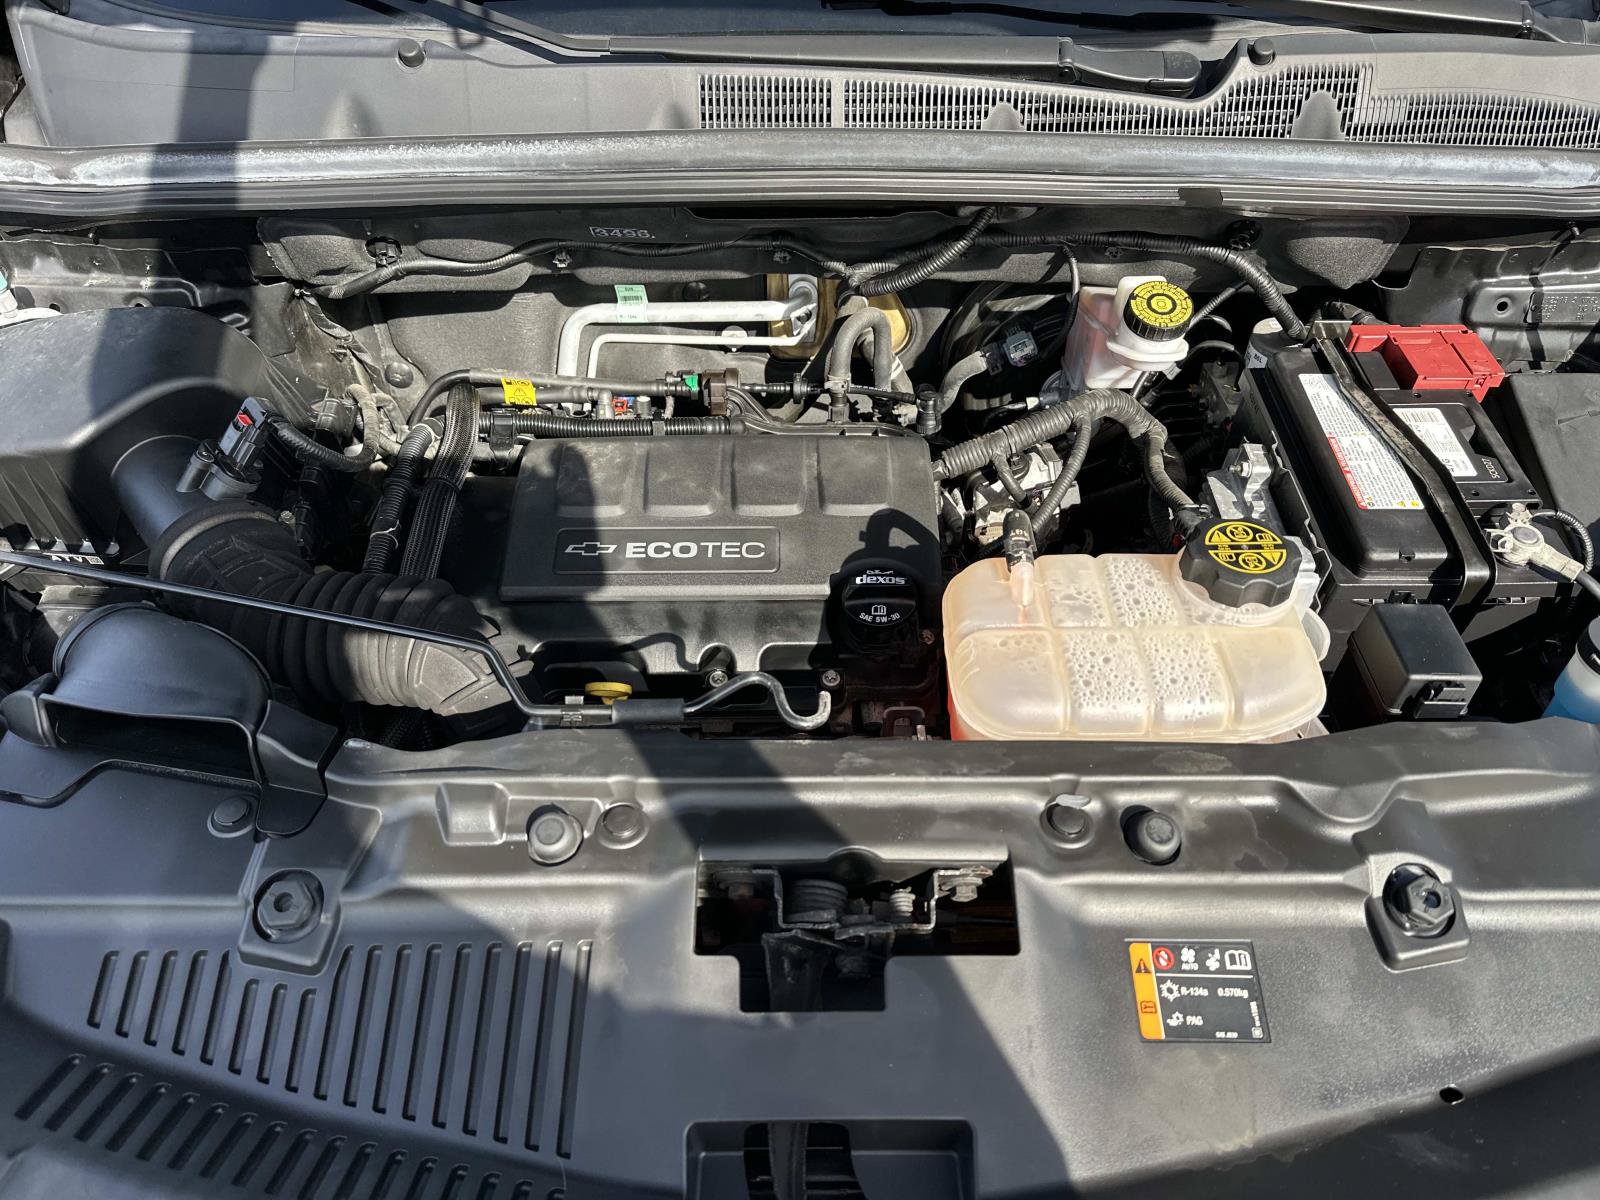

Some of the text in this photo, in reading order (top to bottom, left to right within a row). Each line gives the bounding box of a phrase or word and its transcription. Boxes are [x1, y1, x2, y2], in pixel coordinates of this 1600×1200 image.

[625, 541, 766, 559] ECOTEC
[855, 574, 907, 585] dexos
[859, 612, 900, 623] SAE 5W-30
[1181, 962, 1199, 971] AUTO
[1180, 986, 1209, 996] R-134a
[1186, 1015, 1204, 1026] PAG
